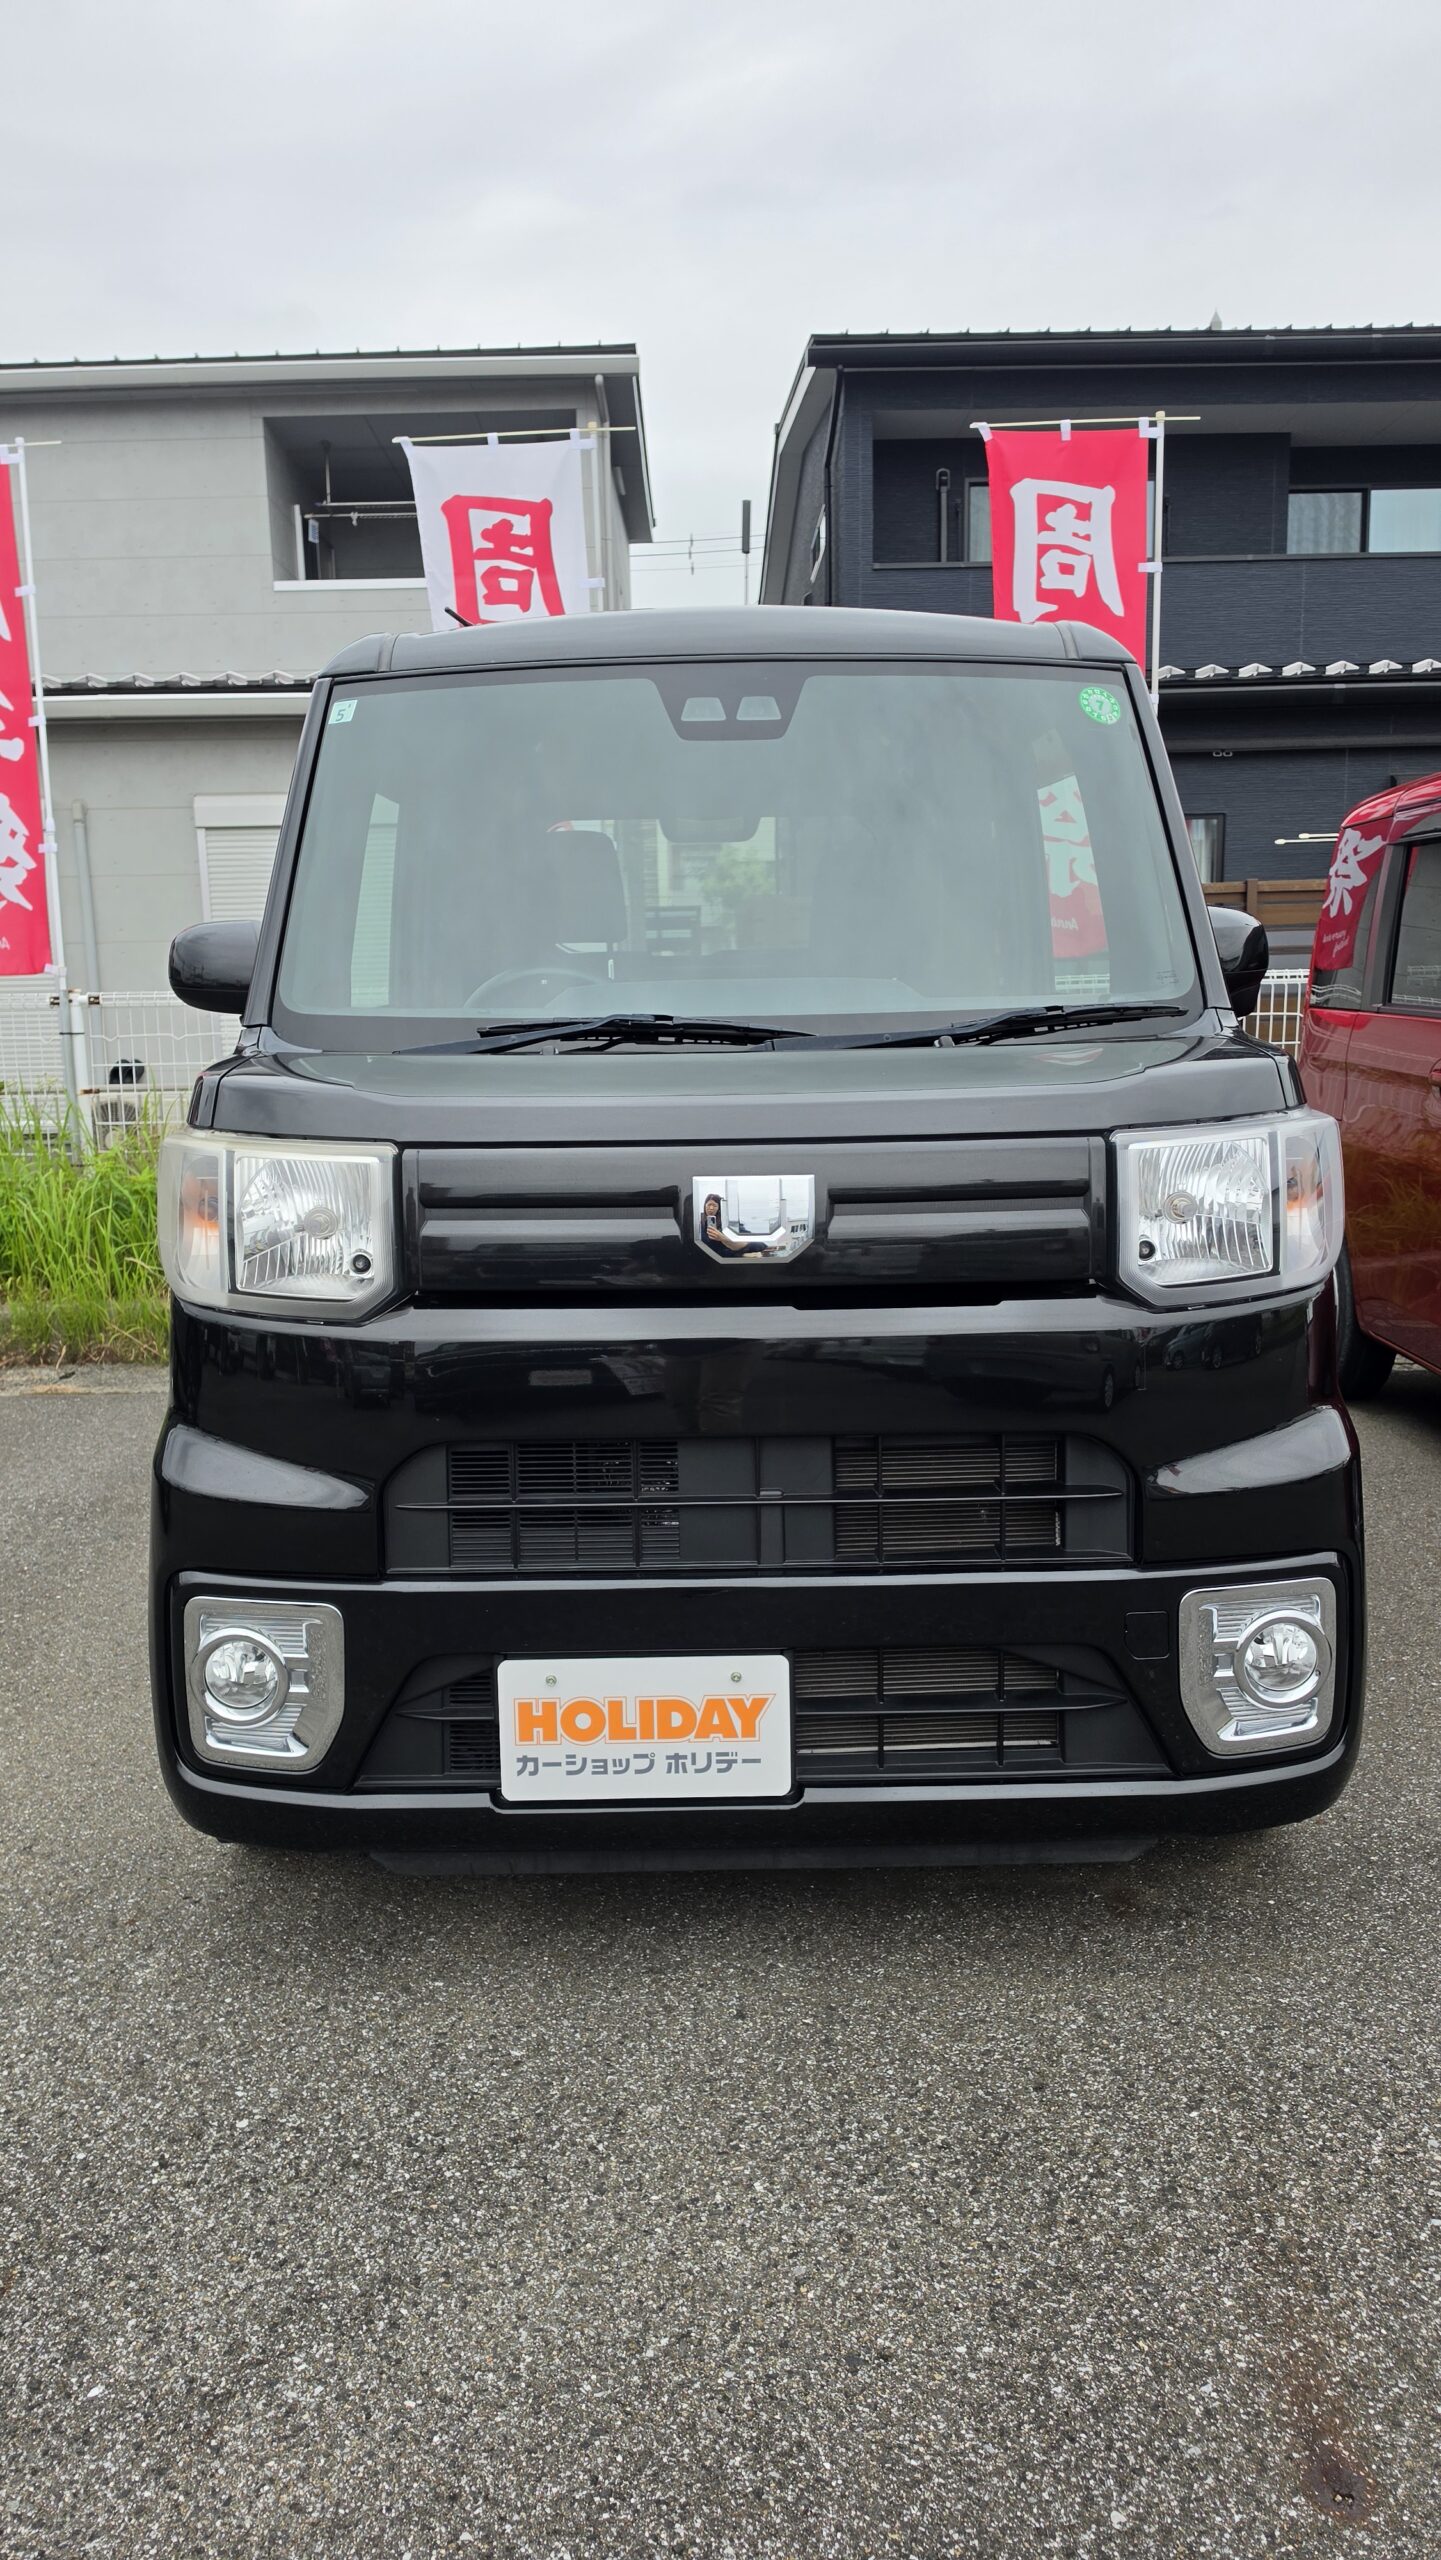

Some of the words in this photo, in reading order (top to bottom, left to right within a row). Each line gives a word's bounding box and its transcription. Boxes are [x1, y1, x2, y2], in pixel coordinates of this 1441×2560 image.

[335, 708, 347, 722] 5
[514, 1693, 776, 1746] HOLIDAY
[516, 1752, 656, 1777] カーショップ
[665, 1751, 762, 1774] ホリデー
